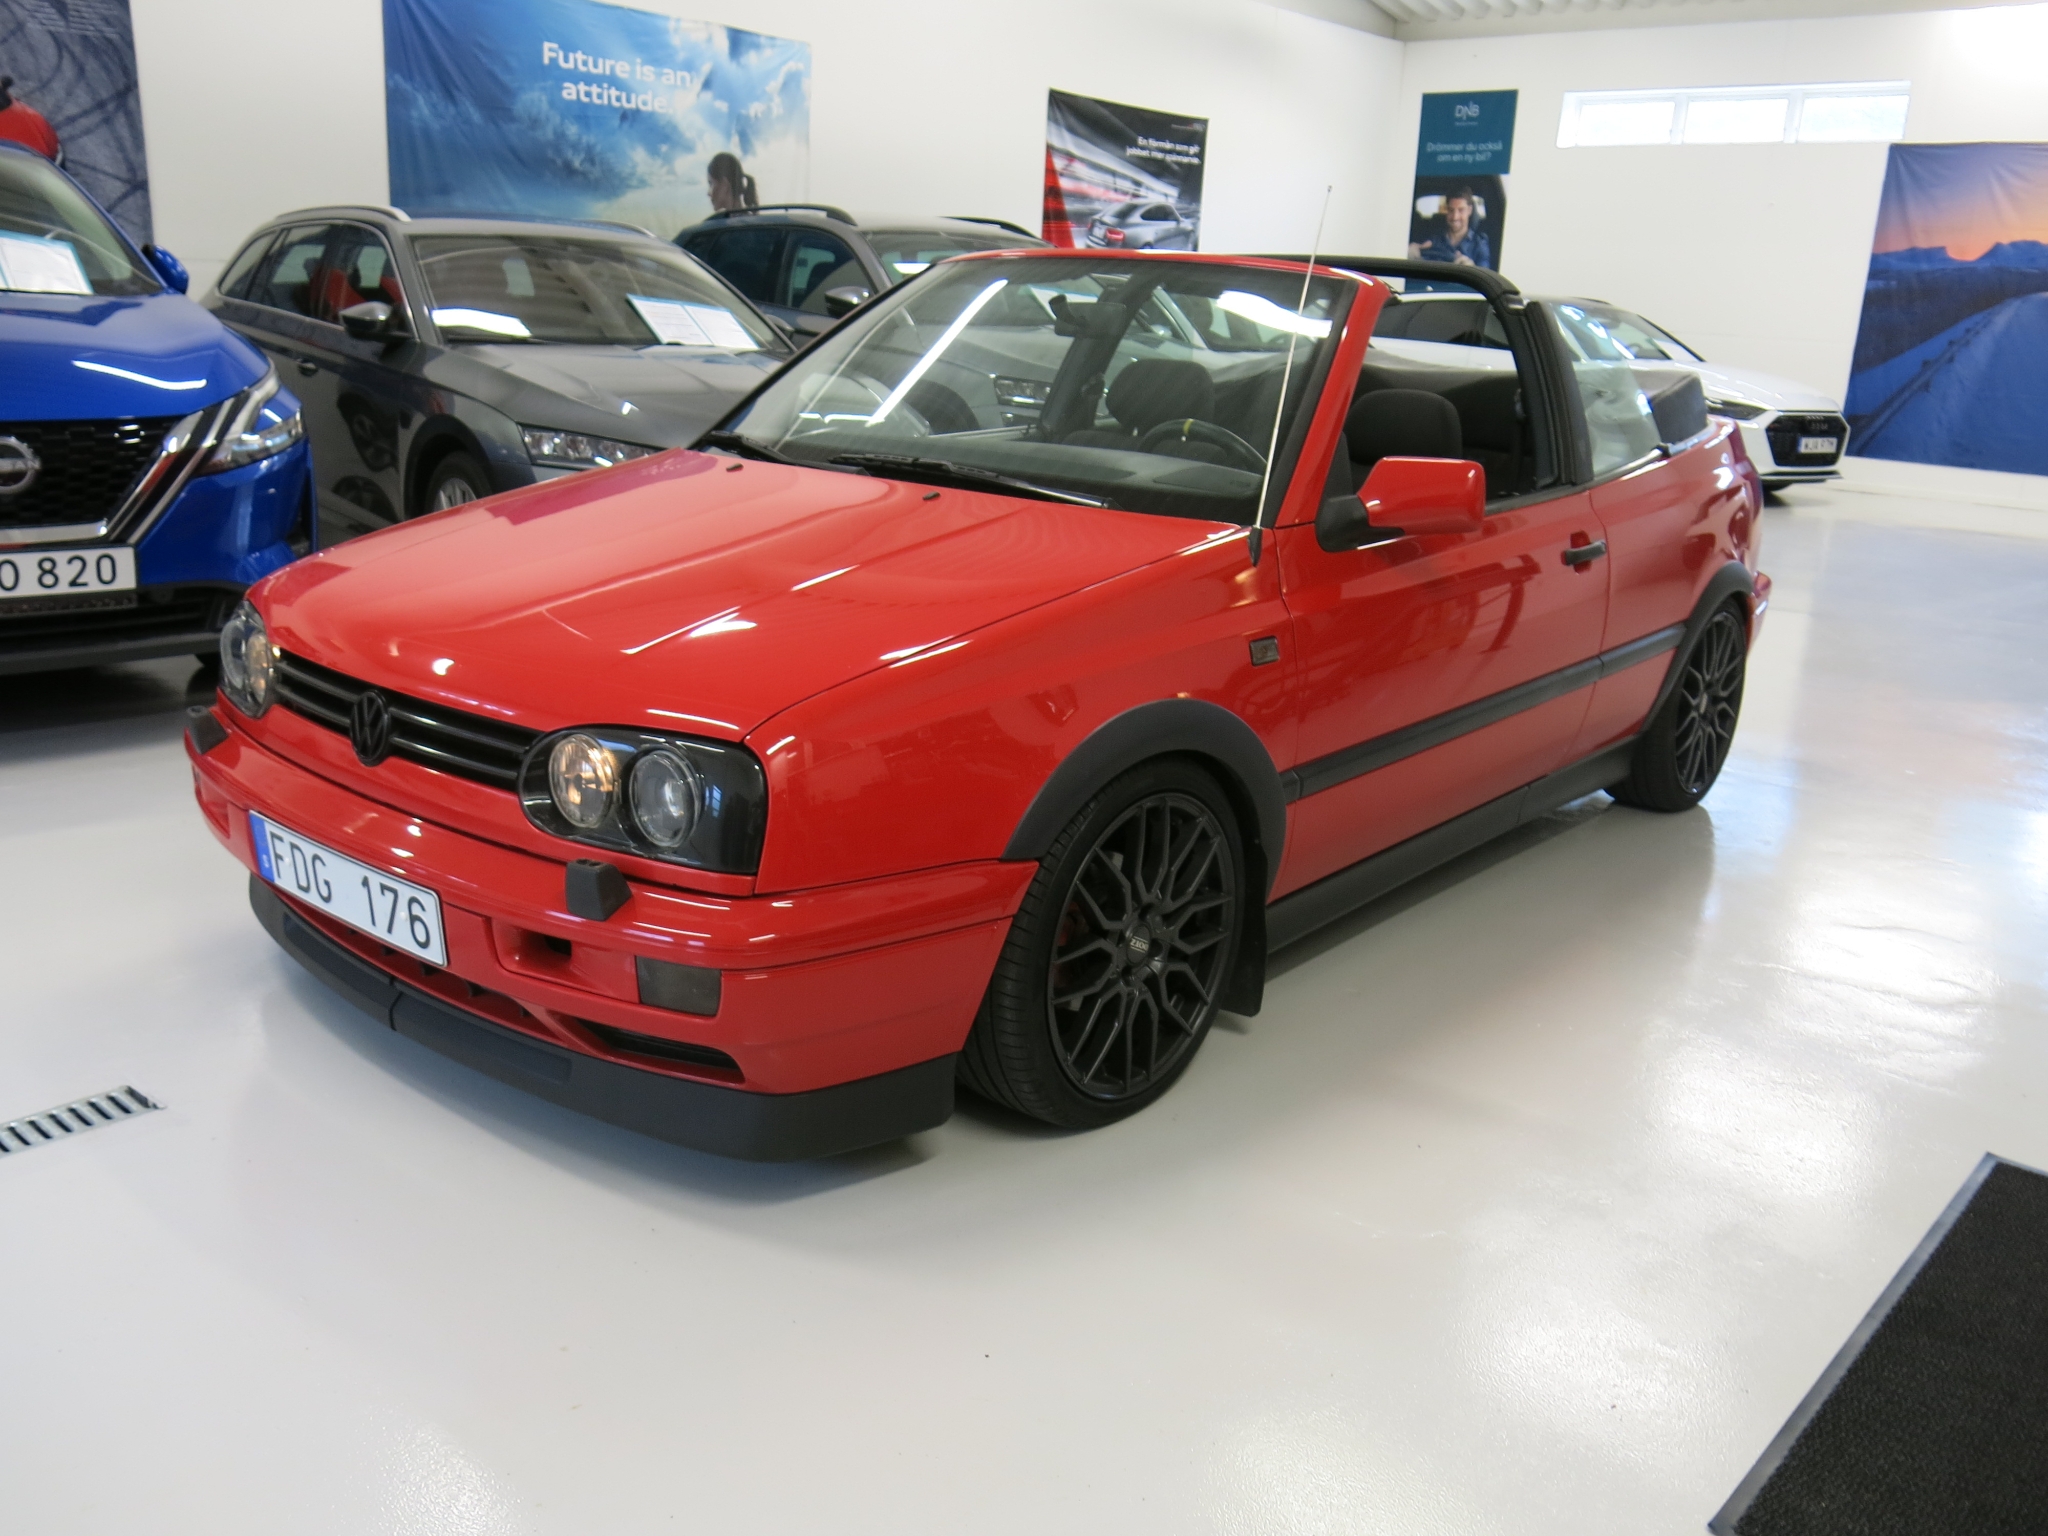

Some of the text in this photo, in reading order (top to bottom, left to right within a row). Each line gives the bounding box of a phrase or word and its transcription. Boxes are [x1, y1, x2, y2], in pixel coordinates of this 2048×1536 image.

[542, 41, 691, 88] Future is an
[561, 81, 673, 114] attitude.
[1138, 135, 1148, 146] En
[38, 554, 117, 588] 820
[269, 830, 431, 950] FDG 176
